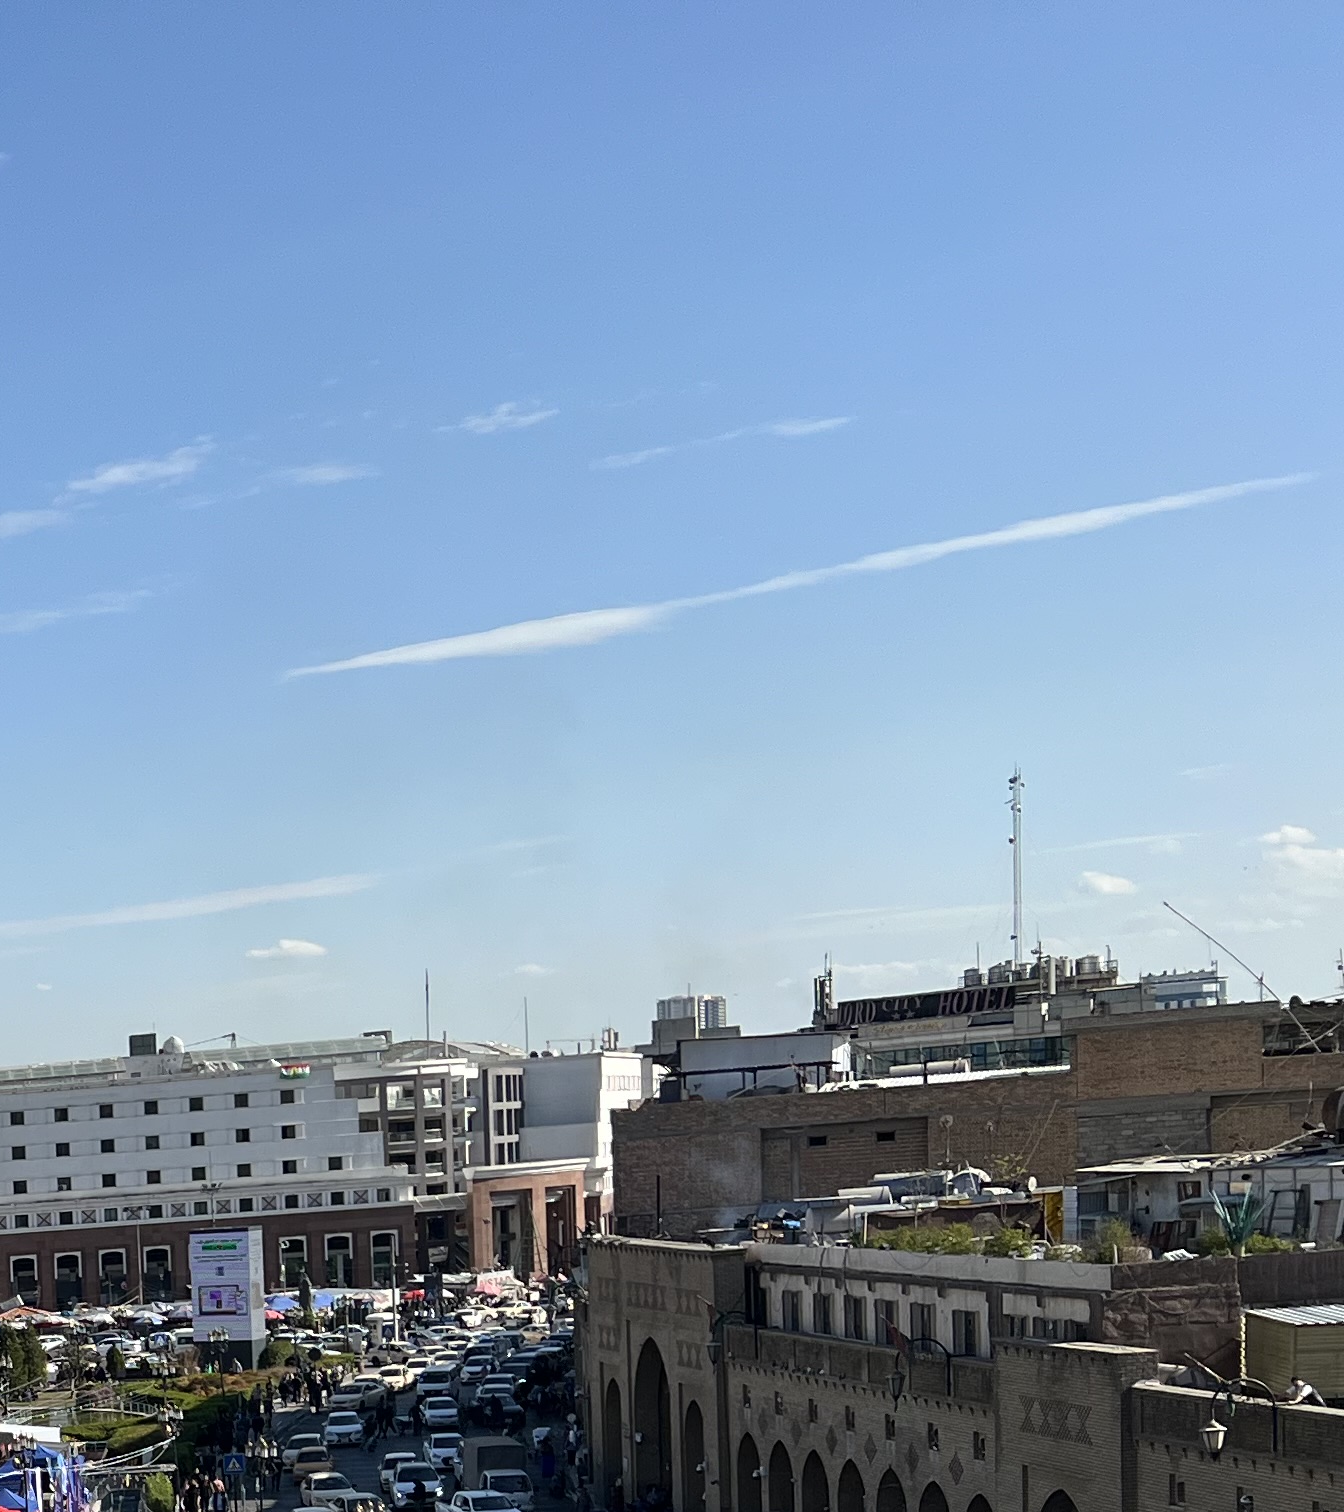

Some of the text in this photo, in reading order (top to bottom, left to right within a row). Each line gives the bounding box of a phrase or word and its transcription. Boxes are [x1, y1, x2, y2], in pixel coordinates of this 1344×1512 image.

[837, 987, 1013, 1027] LORD CITY HOTEL
